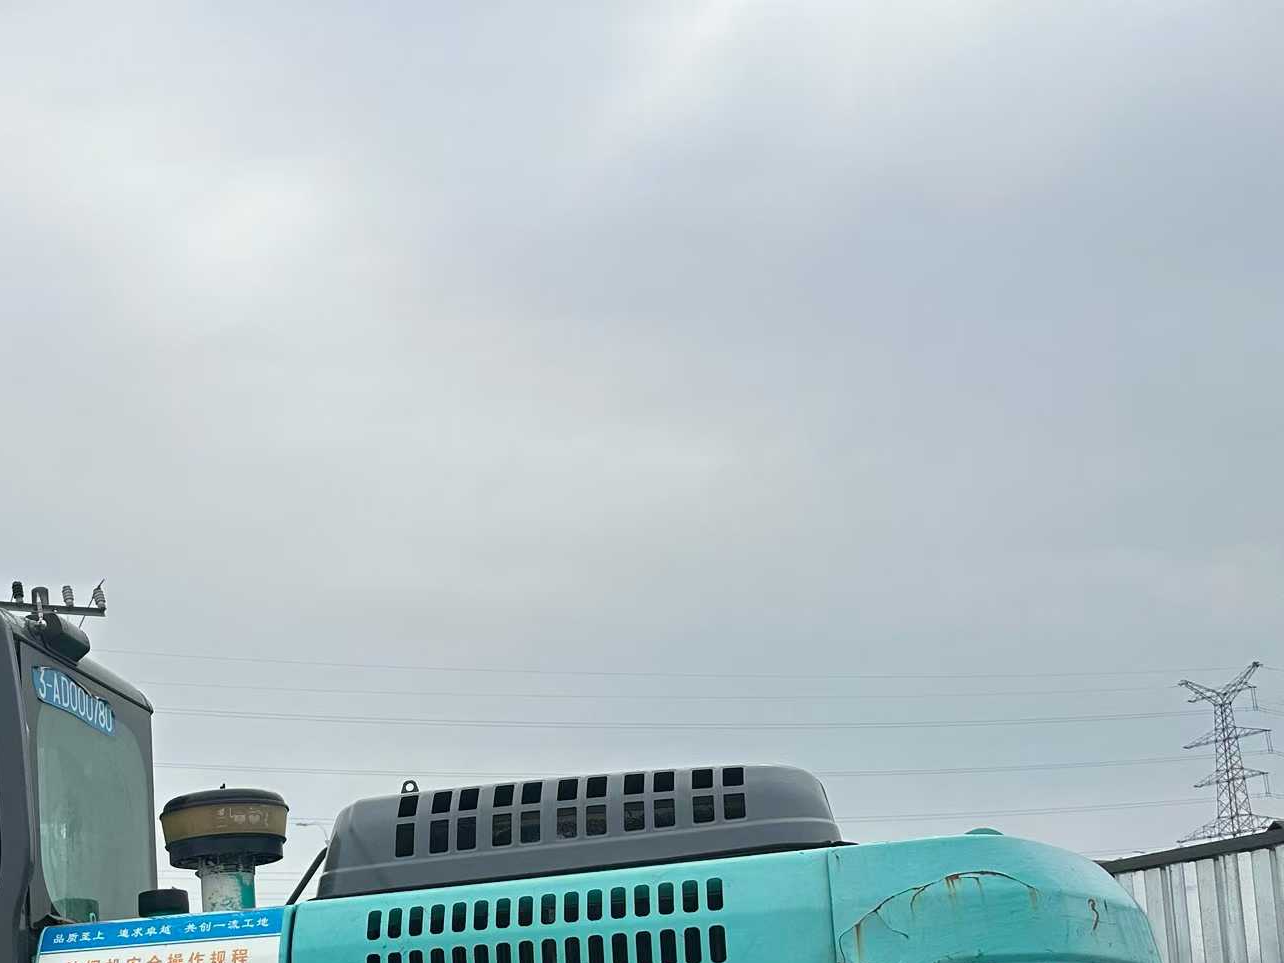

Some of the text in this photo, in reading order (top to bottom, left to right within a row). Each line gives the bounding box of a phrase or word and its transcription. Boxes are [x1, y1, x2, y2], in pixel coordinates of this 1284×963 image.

[53, 917, 269, 944] 品质至上 追求卓越 共创一流工地
